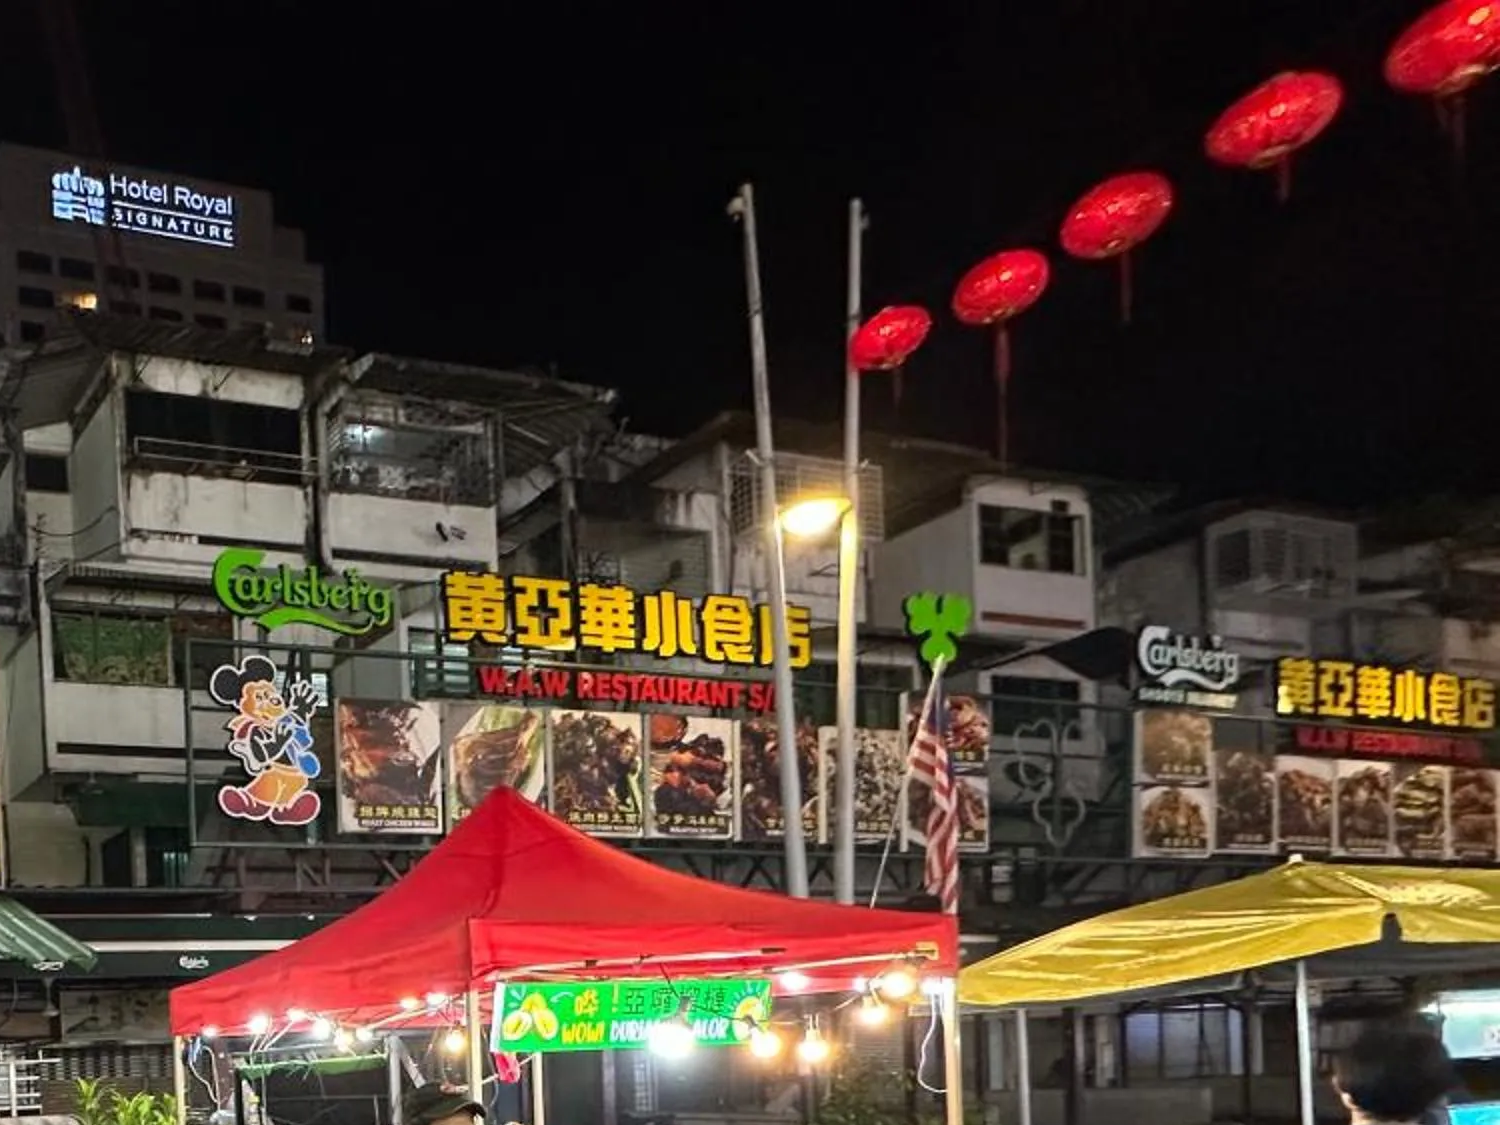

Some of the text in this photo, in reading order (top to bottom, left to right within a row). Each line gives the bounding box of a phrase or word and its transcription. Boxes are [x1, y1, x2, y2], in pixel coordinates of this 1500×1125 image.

[109, 173, 234, 216] Hotel Royal
[112, 208, 235, 241] SIGNATURE
[213, 546, 392, 630] Carlsberg
[1138, 625, 1240, 687] Carlsberg
[576, 671, 746, 707] RESTAURANT
